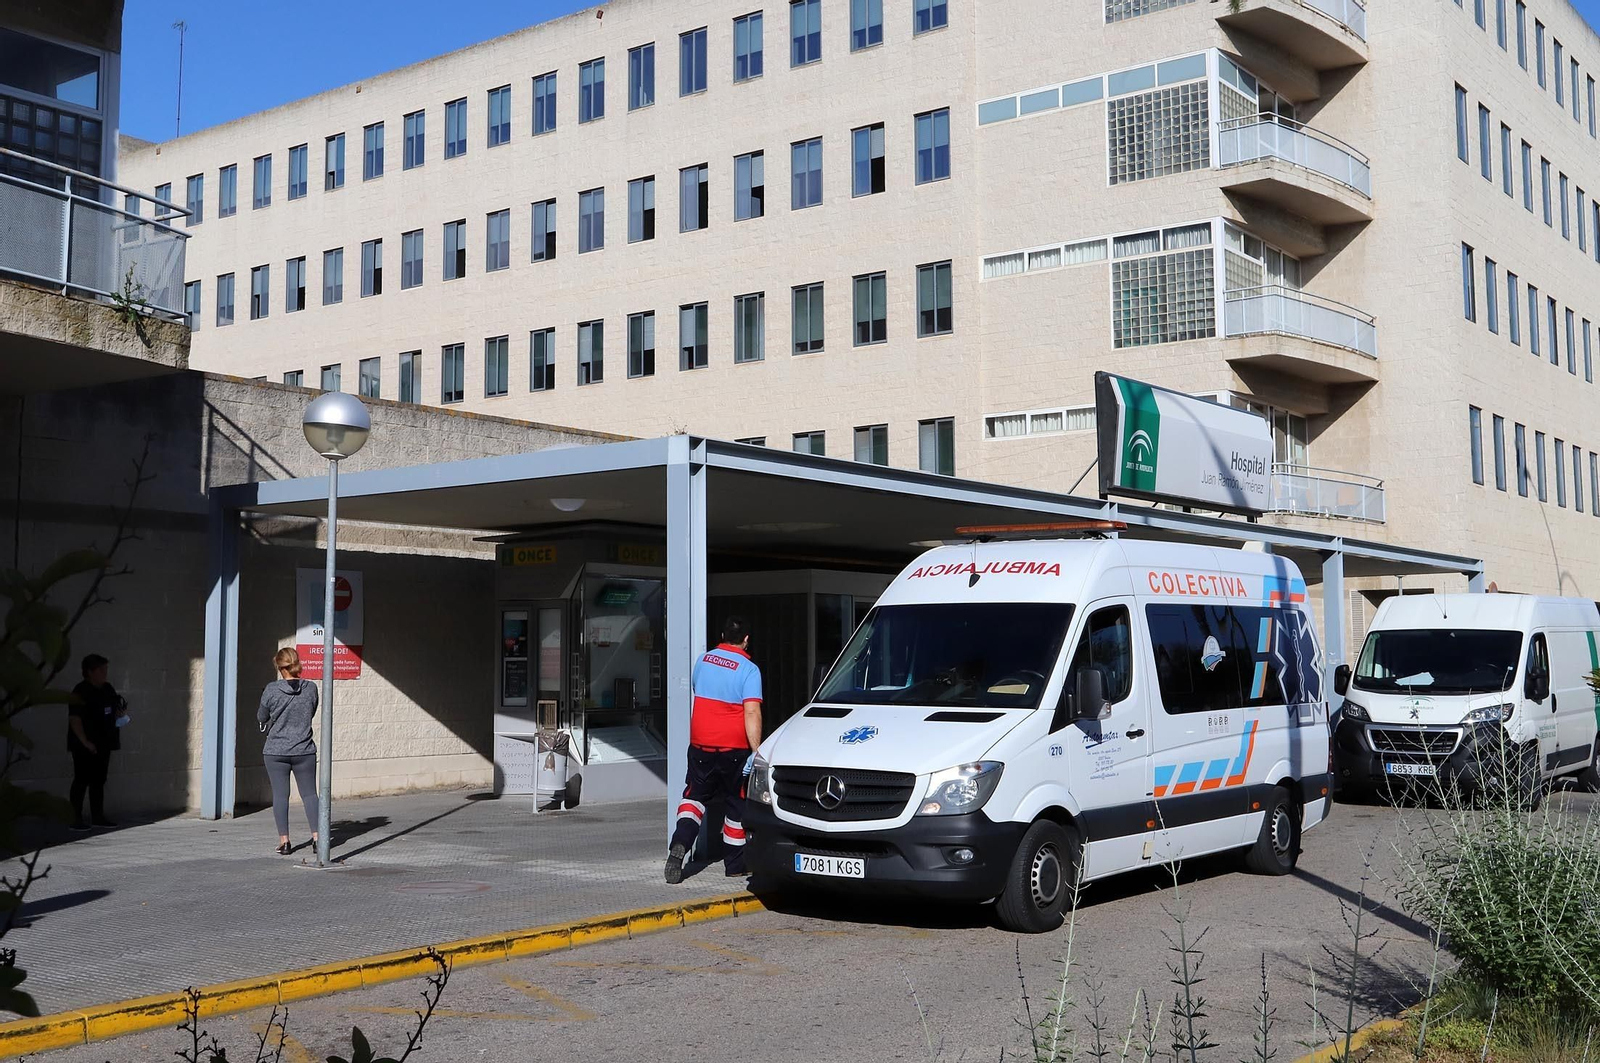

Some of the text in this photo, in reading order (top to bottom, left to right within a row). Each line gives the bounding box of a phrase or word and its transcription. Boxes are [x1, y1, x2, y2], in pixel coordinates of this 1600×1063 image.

[1231, 451, 1265, 477] Hospital
[1201, 470, 1217, 486] Juan
[1218, 472, 1240, 489] Ramón
[517, 548, 552, 562] ONCE
[623, 547, 656, 562] ONCE
[1148, 571, 1247, 597] COLECTIVA
[313, 628, 323, 636] sin
[309, 647, 349, 655] ¡RECRDE!
[1050, 746, 1063, 757] 270
[1392, 764, 1413, 774] 6853
[803, 857, 861, 875] 7081 KGS
